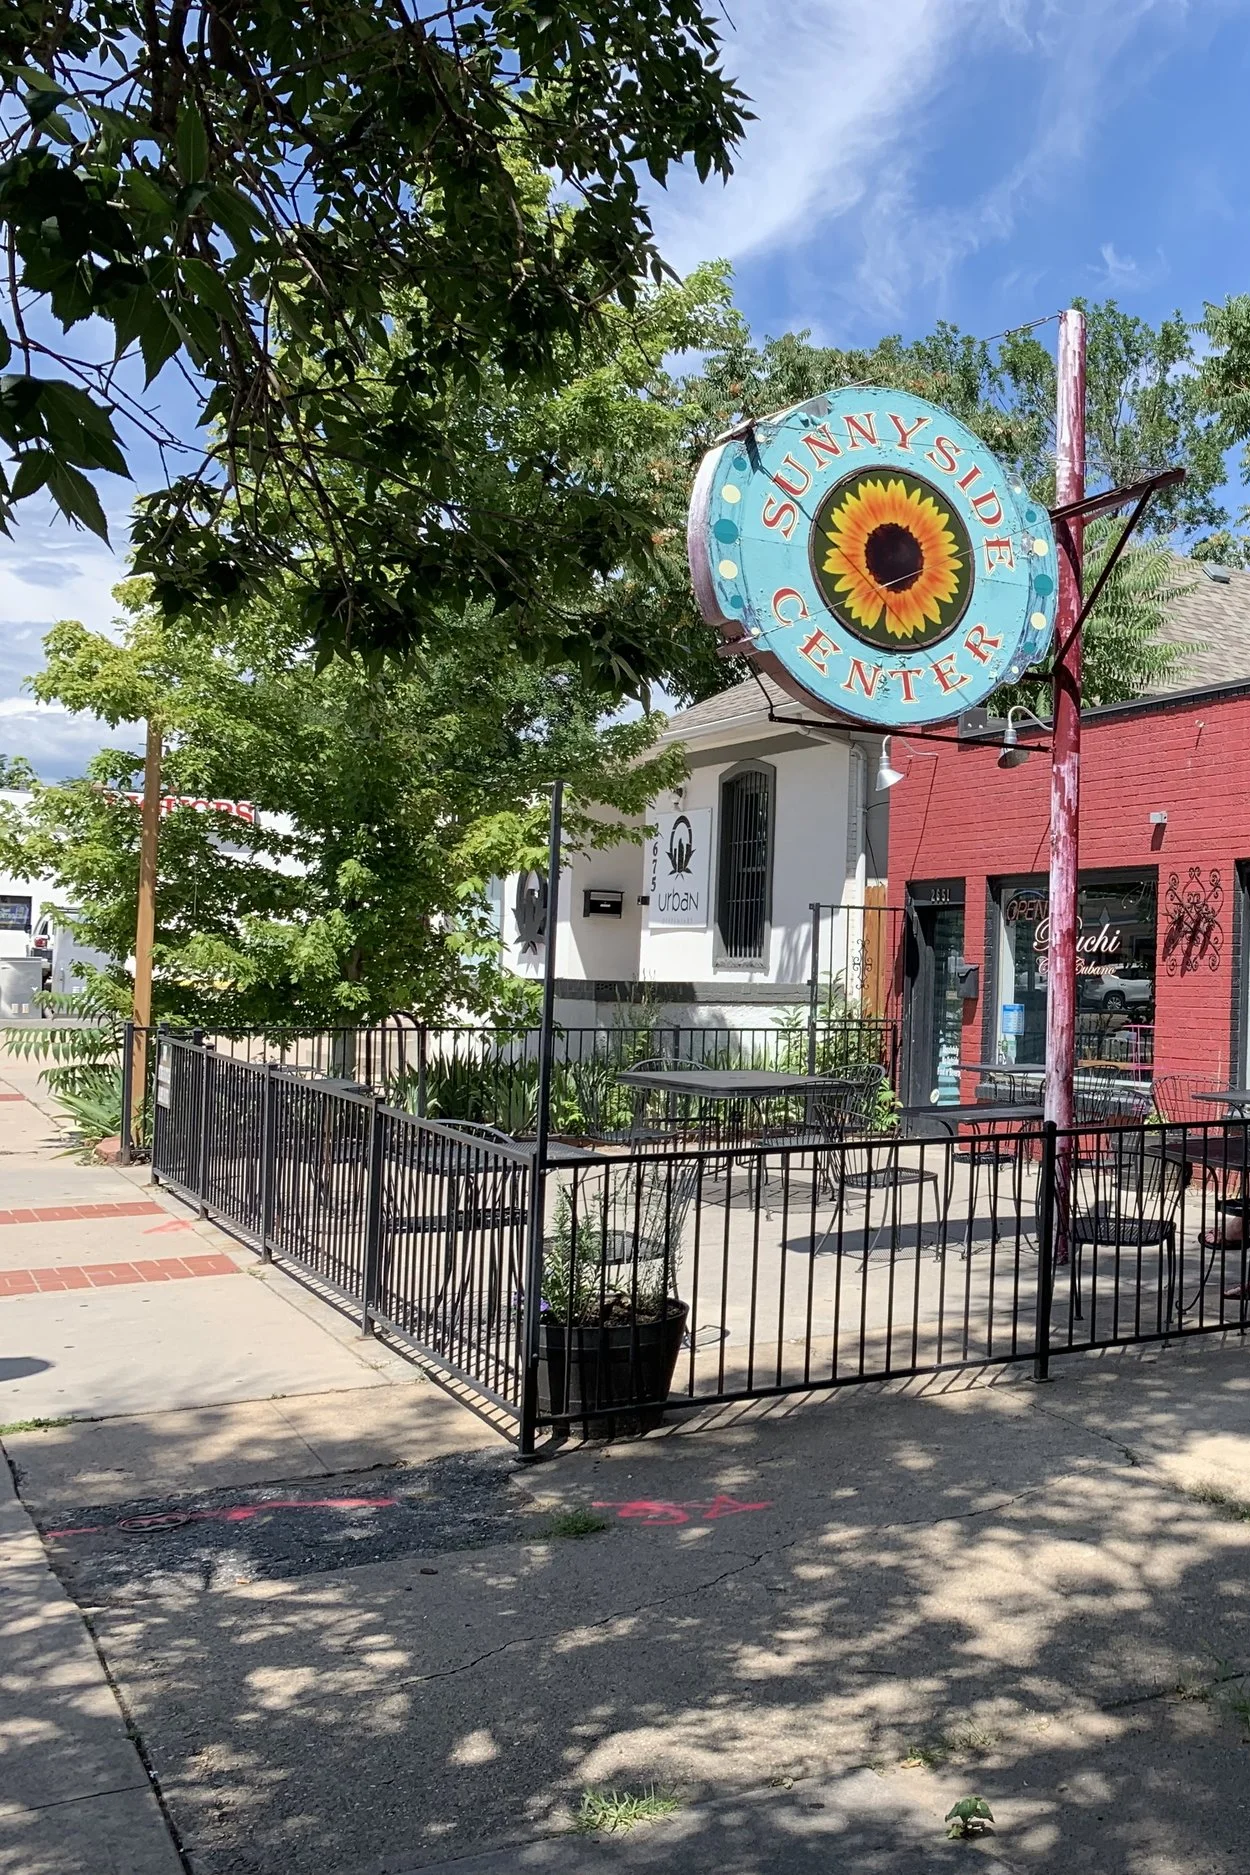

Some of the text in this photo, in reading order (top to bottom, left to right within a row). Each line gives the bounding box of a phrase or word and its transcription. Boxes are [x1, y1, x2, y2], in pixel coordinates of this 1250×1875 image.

[760, 411, 1016, 576] SUNNYSIDE
[770, 586, 1003, 704] CENTER
[1006, 899, 1050, 921] OPEN
